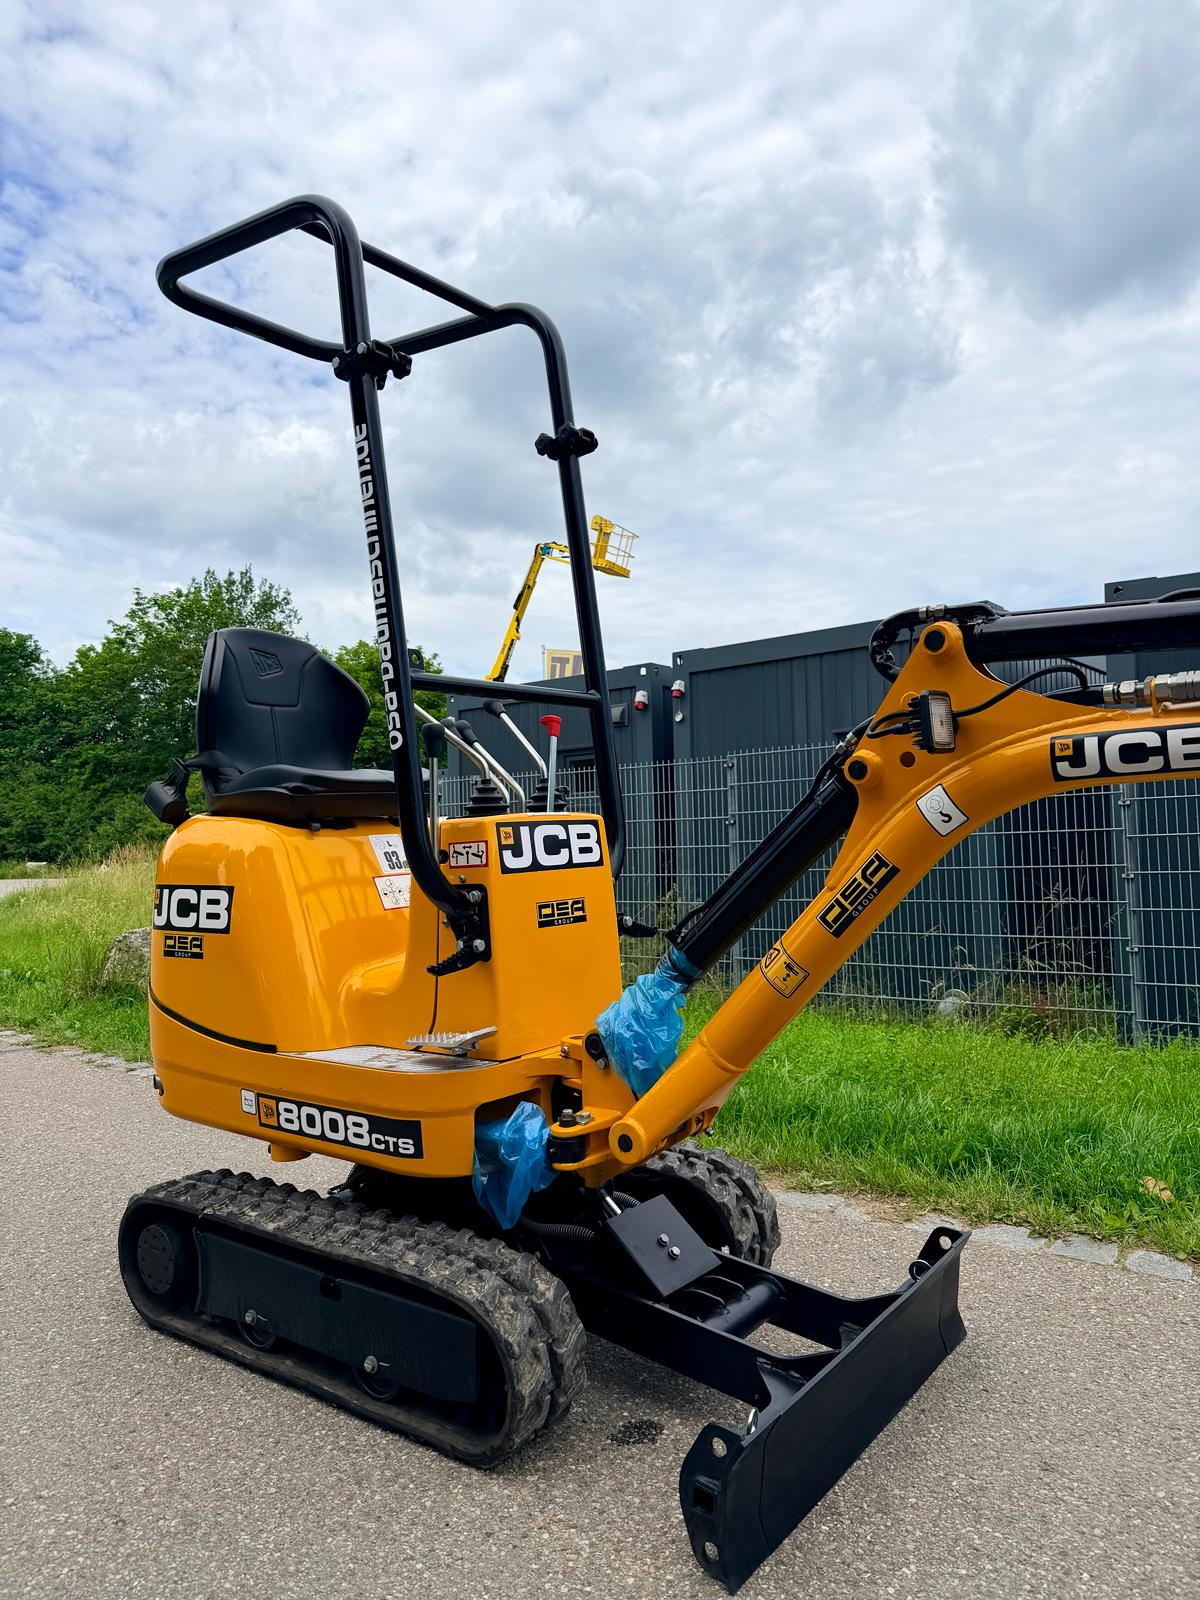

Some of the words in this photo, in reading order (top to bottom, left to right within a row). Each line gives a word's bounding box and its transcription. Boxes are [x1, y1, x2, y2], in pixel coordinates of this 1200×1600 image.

[502, 824, 601, 869] JCB
[154, 888, 229, 929] JCB
[852, 887, 879, 917] GROUP
